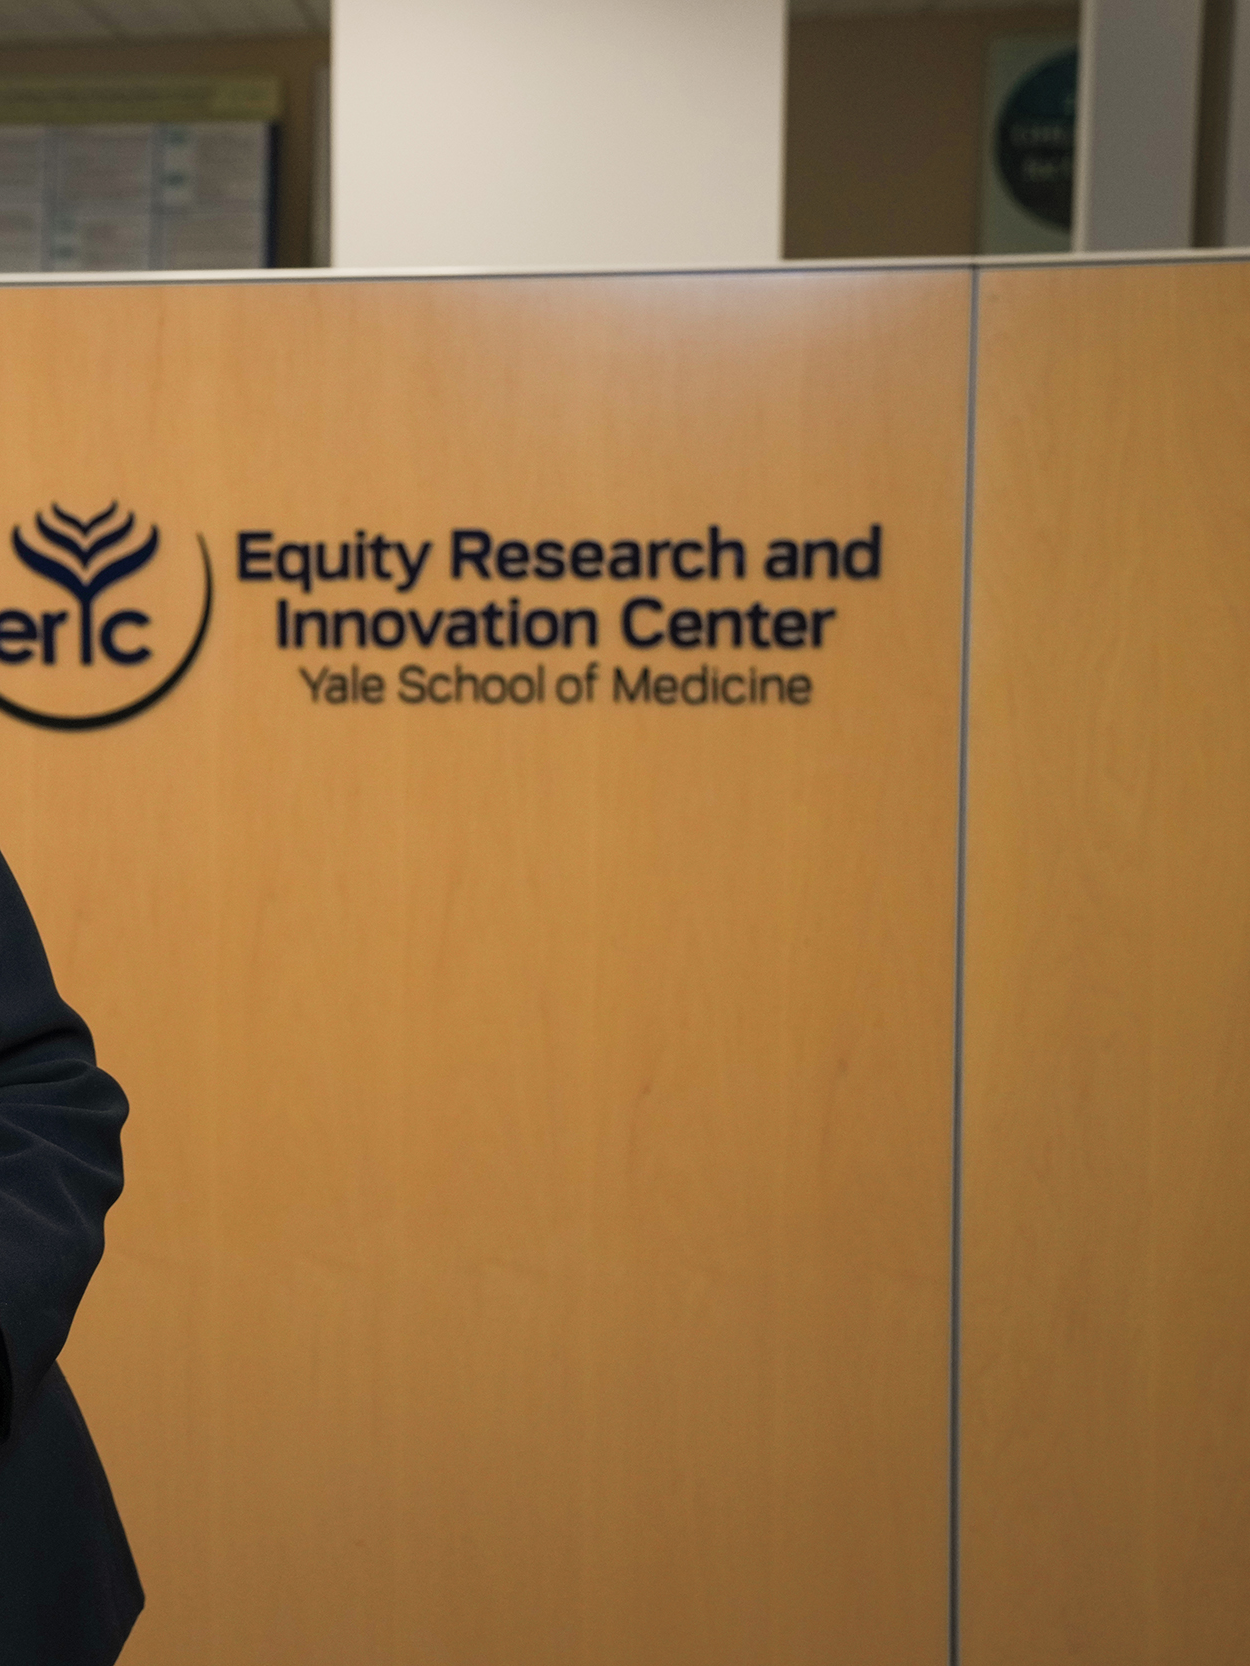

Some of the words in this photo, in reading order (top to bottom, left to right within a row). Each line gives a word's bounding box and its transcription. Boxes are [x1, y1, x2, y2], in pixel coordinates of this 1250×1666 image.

[236, 529, 432, 594] Equity
[450, 525, 746, 581] Research
[763, 522, 884, 582] and
[276, 596, 598, 650] Innovation
[620, 595, 838, 650] Center
[299, 664, 386, 705] Yale
[398, 662, 546, 705] School
[555, 661, 600, 705] of
[612, 663, 814, 706] Medicine
